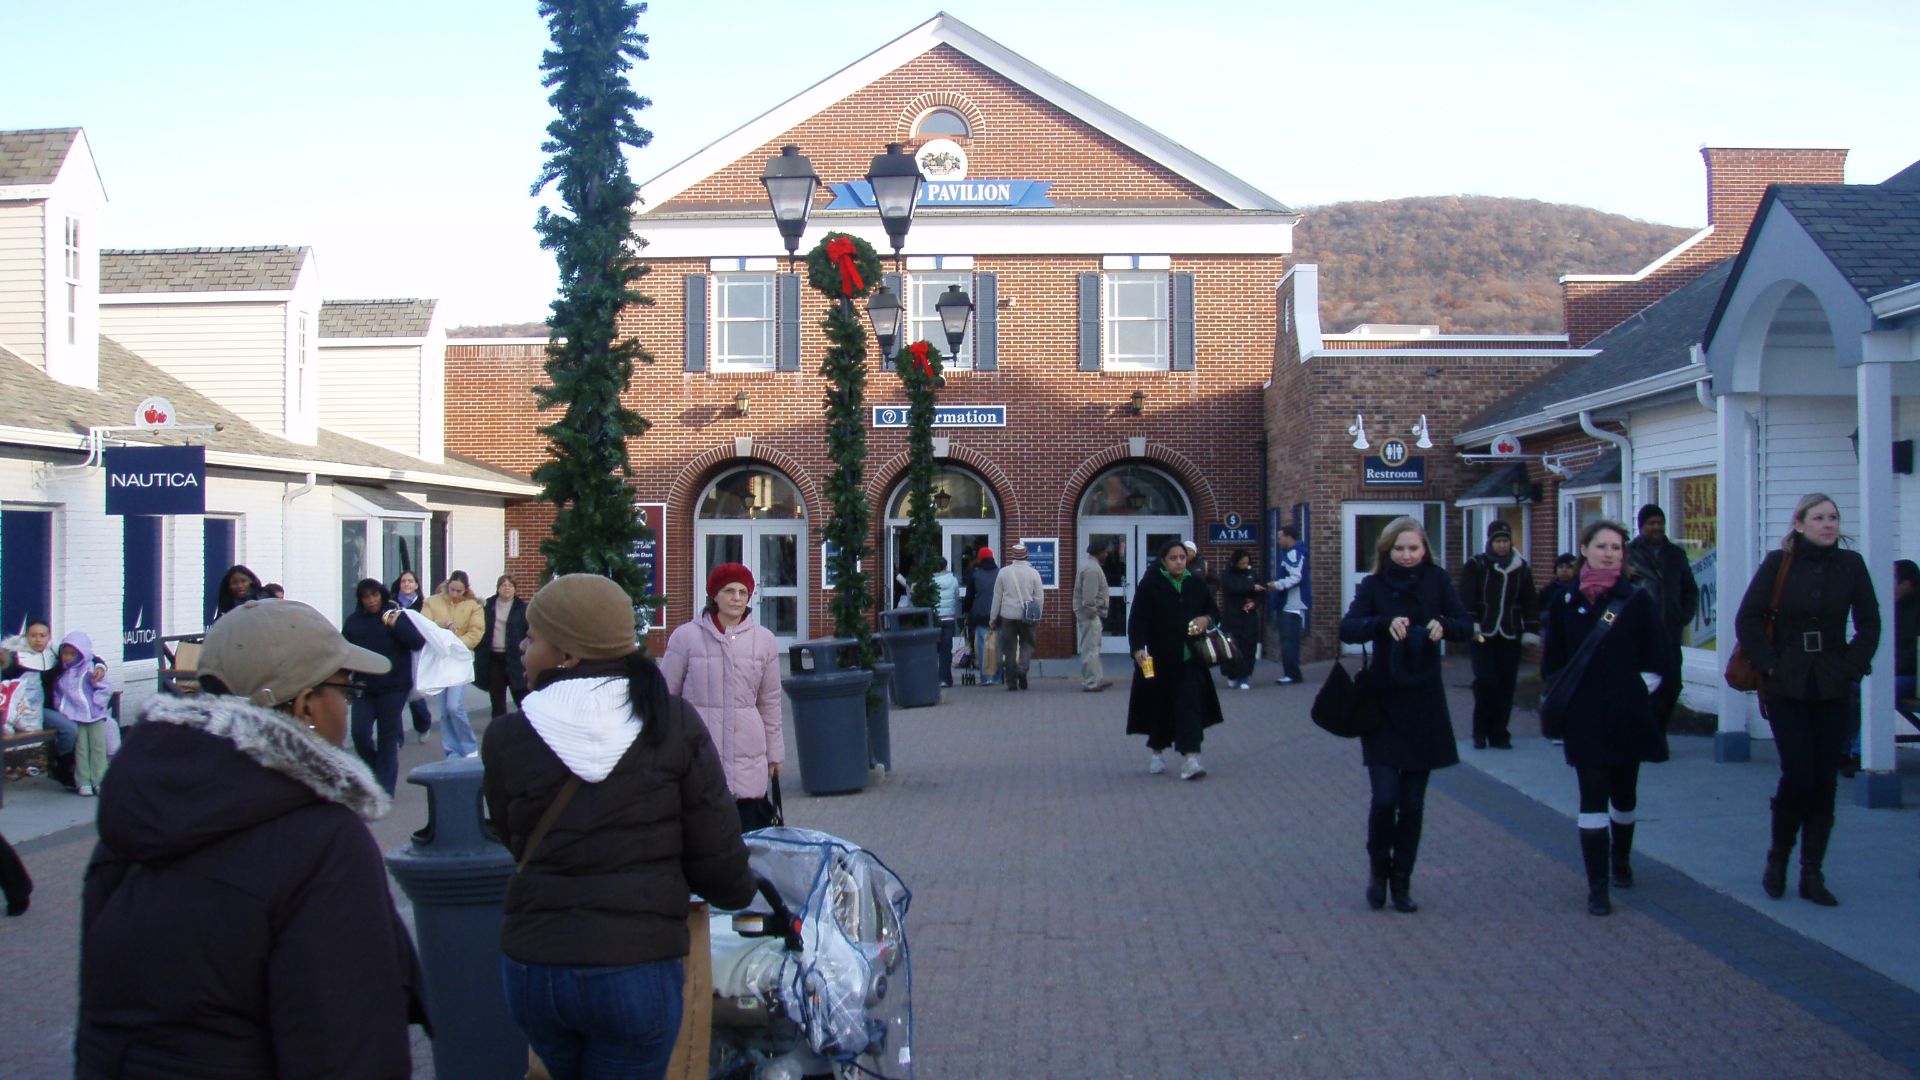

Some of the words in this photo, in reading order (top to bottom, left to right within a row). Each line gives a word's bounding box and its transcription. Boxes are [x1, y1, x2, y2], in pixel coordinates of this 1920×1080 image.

[928, 184, 1010, 201] PAVILION
[901, 410, 997, 424] Irmation
[112, 473, 198, 487] NAUTICA
[1366, 468, 1418, 479] Restroom
[1219, 530, 1248, 539] ATM
